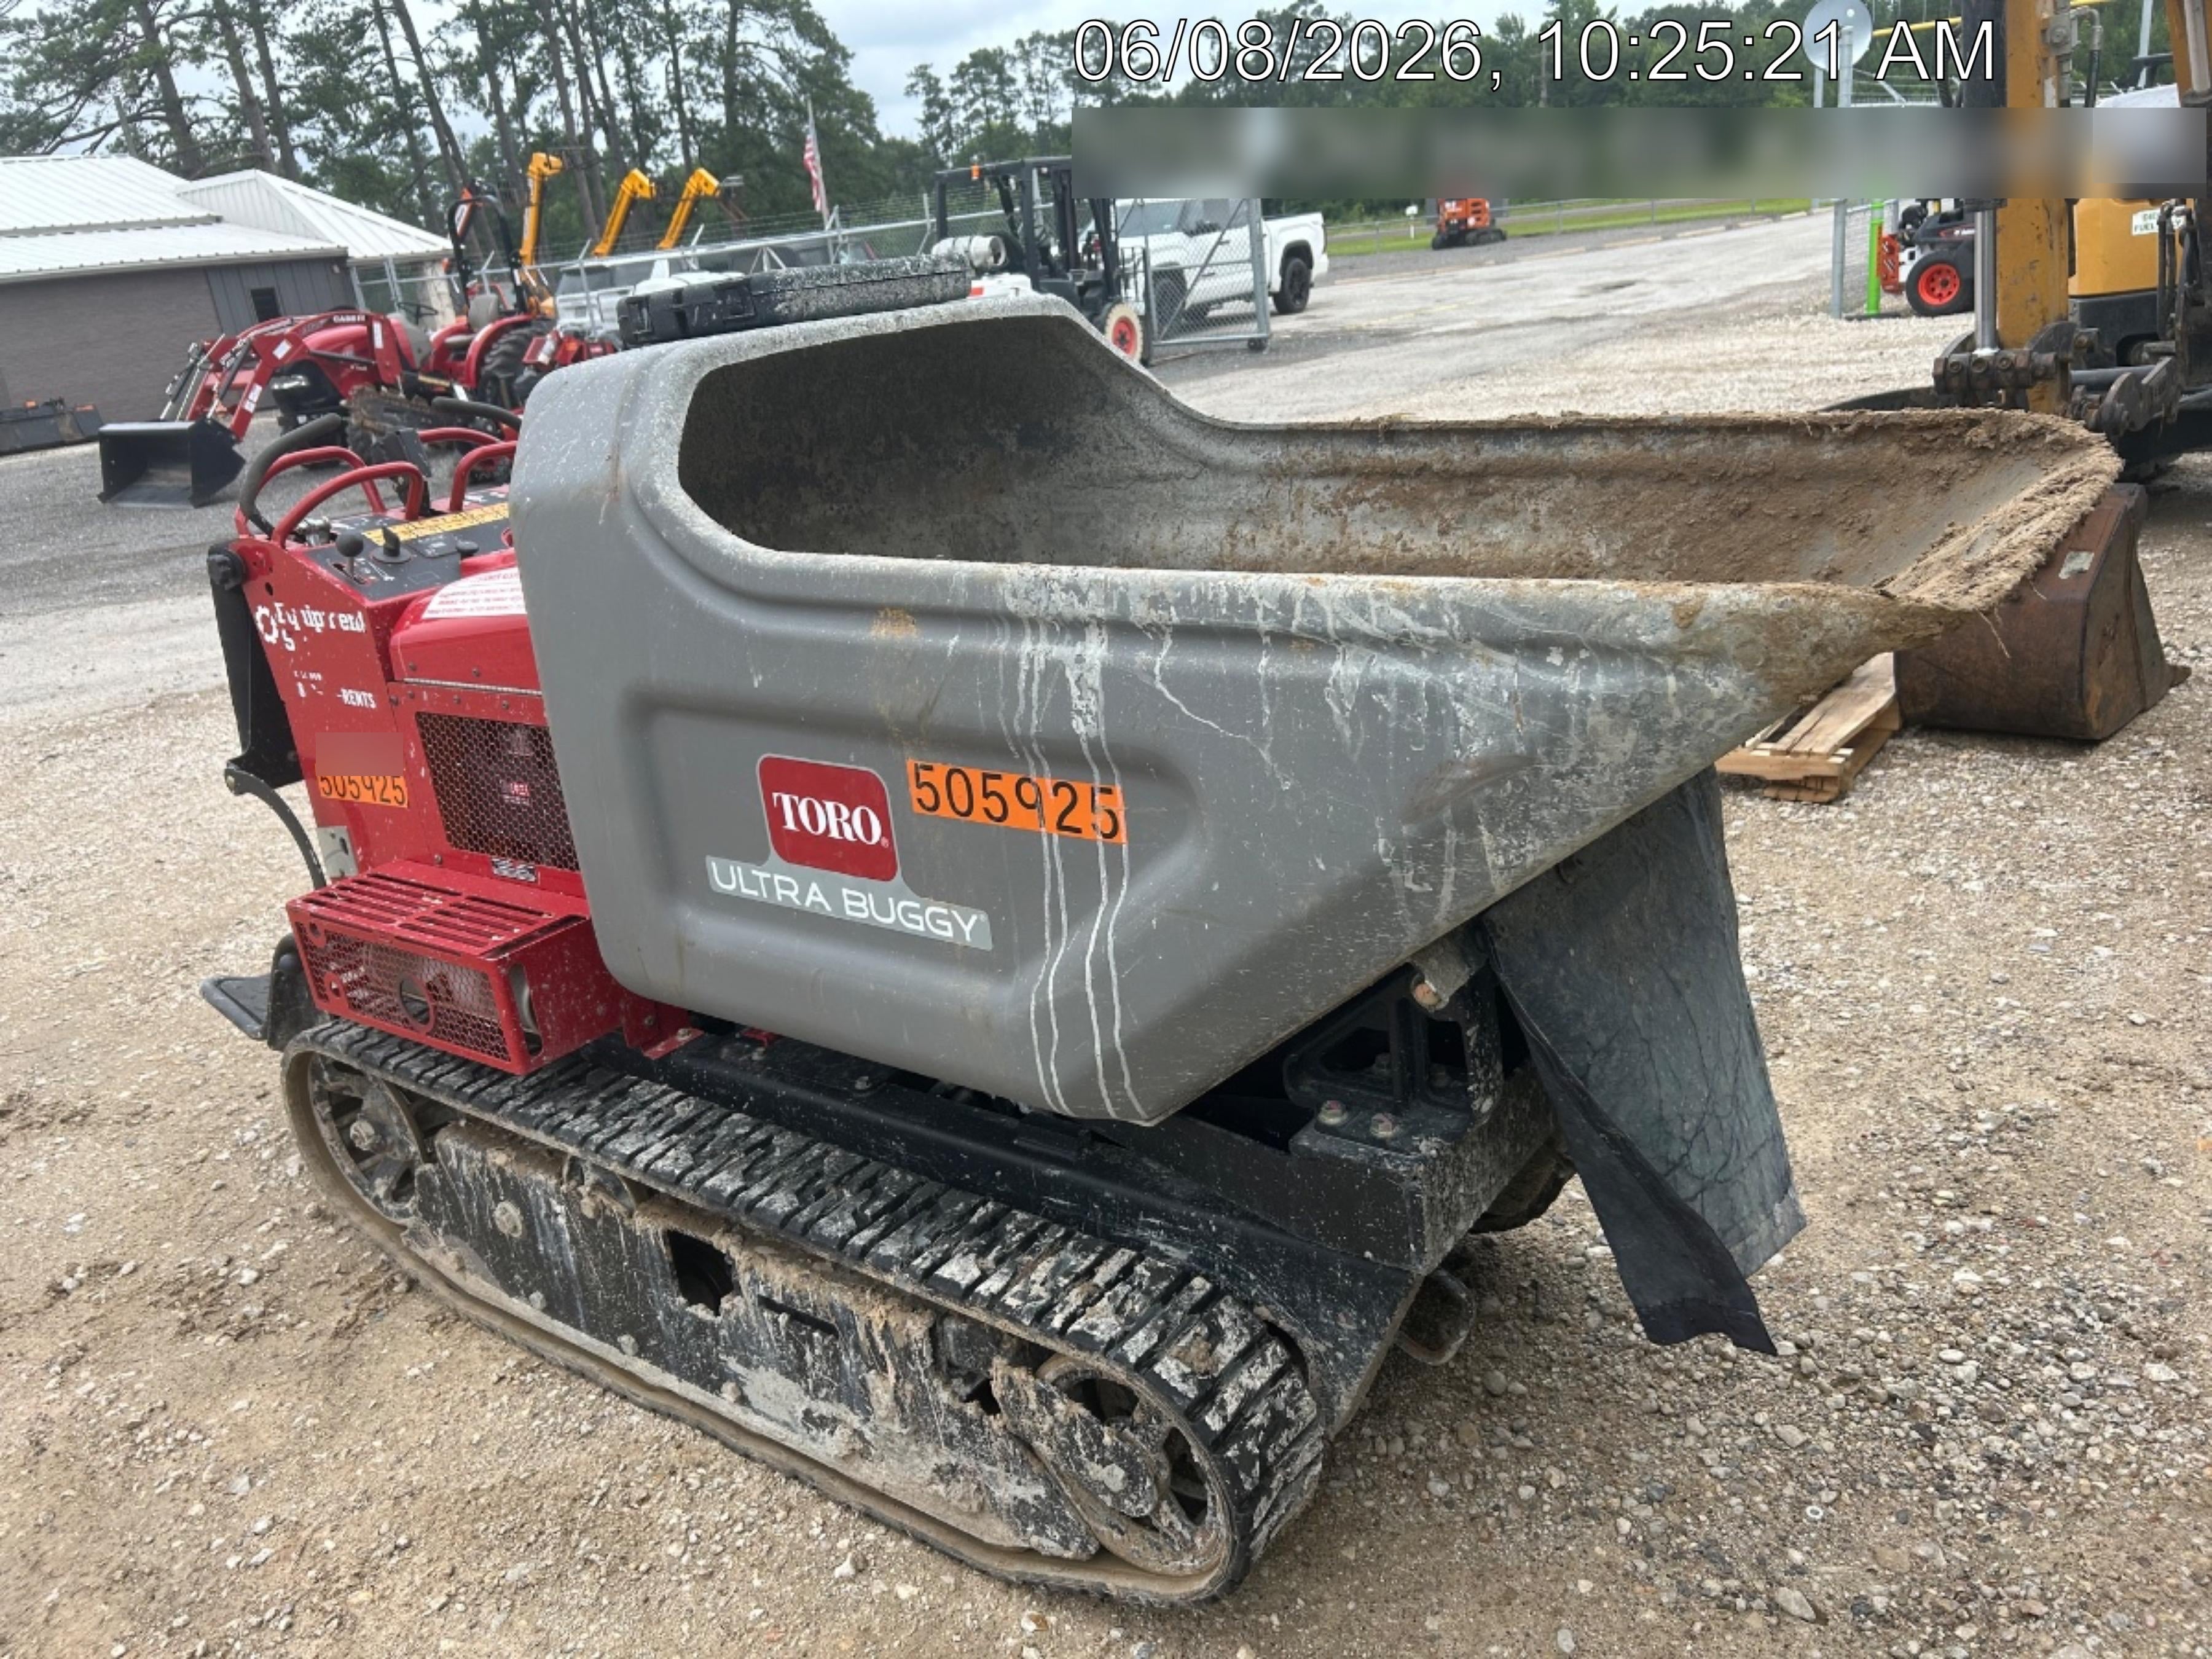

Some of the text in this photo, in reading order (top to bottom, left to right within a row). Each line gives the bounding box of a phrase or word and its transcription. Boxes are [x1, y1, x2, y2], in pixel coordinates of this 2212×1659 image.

[772, 792, 882, 845] TORO
[914, 762, 1120, 839] 505925
[710, 861, 978, 943] ULTRA BUGGY
